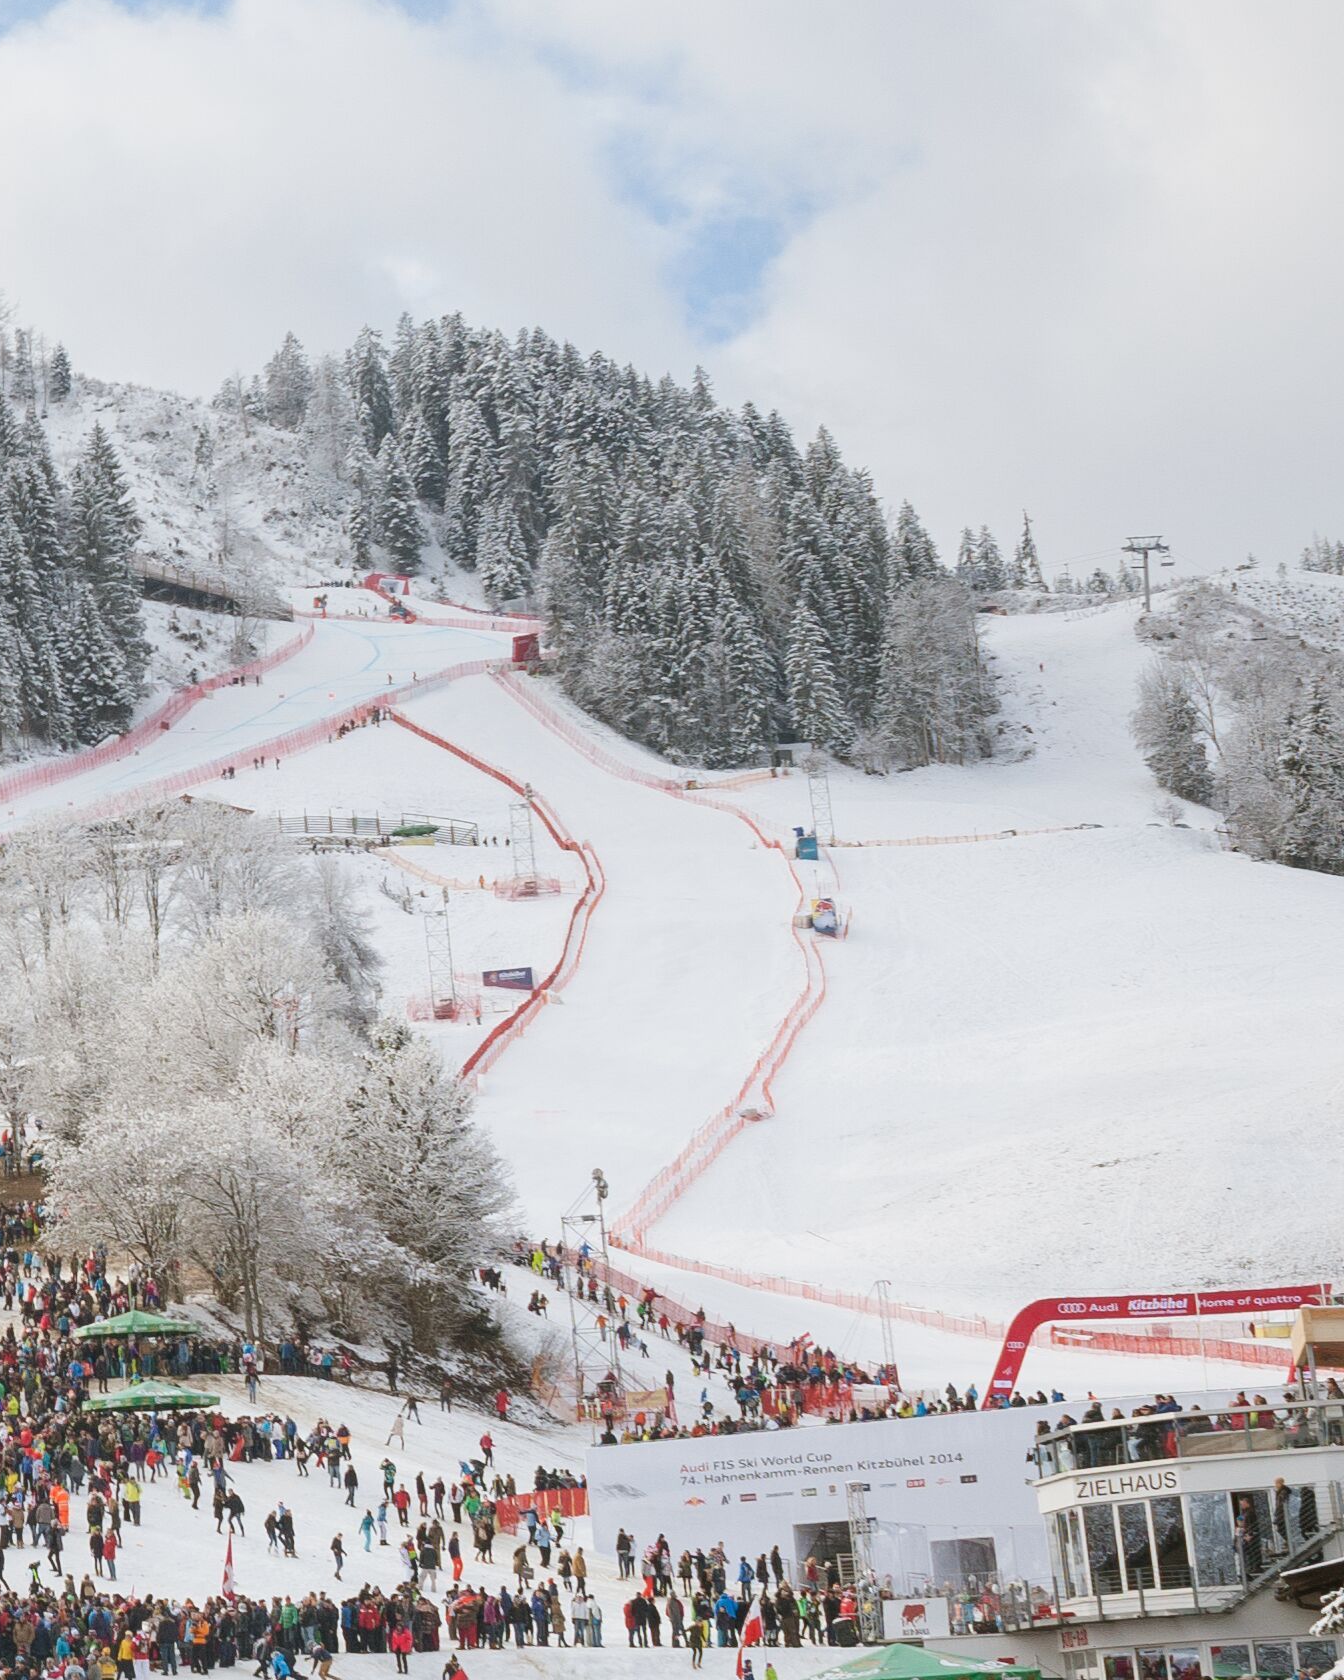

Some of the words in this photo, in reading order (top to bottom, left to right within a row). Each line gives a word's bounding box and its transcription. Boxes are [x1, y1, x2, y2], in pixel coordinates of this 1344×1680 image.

[1090, 1303, 1119, 1313] Audi
[1127, 1297, 1187, 1311] Kitzbühel
[1199, 1297, 1234, 1309] Home
[1237, 1295, 1251, 1307] of
[1253, 1294, 1302, 1307] quattro
[680, 1463, 710, 1474] Audi
[713, 1460, 735, 1472] FIS
[738, 1457, 758, 1469] Ski
[762, 1455, 803, 1468] World
[807, 1453, 832, 1465] Cup
[680, 1475, 701, 1486] 74.
[705, 1464, 853, 1484] Hahnenkamm-Rennen
[857, 1458, 925, 1471] Kitzbühel
[929, 1452, 964, 1465] 2014
[1076, 1472, 1177, 1498] ZIELHAUS
